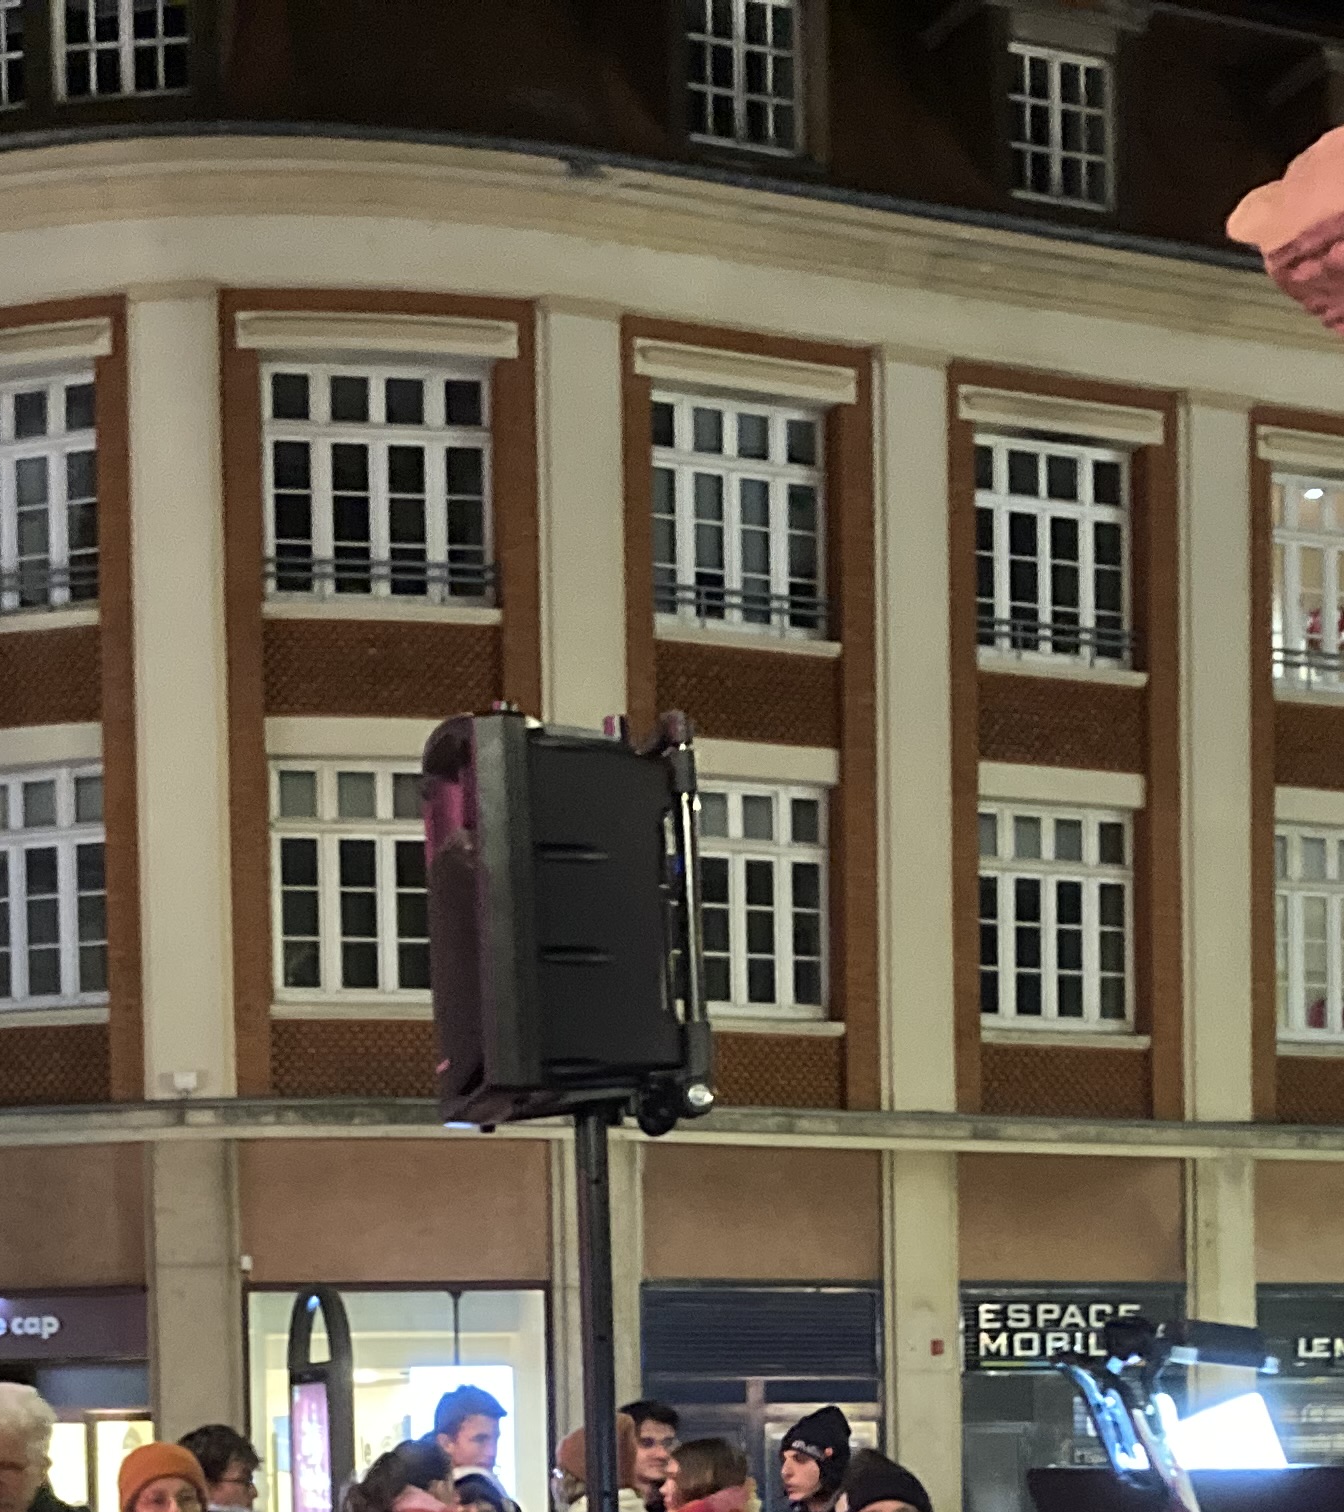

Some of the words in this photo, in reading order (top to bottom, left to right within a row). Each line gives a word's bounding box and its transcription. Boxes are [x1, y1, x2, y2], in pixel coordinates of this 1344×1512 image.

[11, 1316, 60, 1340] cap
[978, 1303, 1141, 1329] ESPACE
[978, 1332, 1111, 1357] MOBIL
[1297, 1337, 1331, 1358] LE
